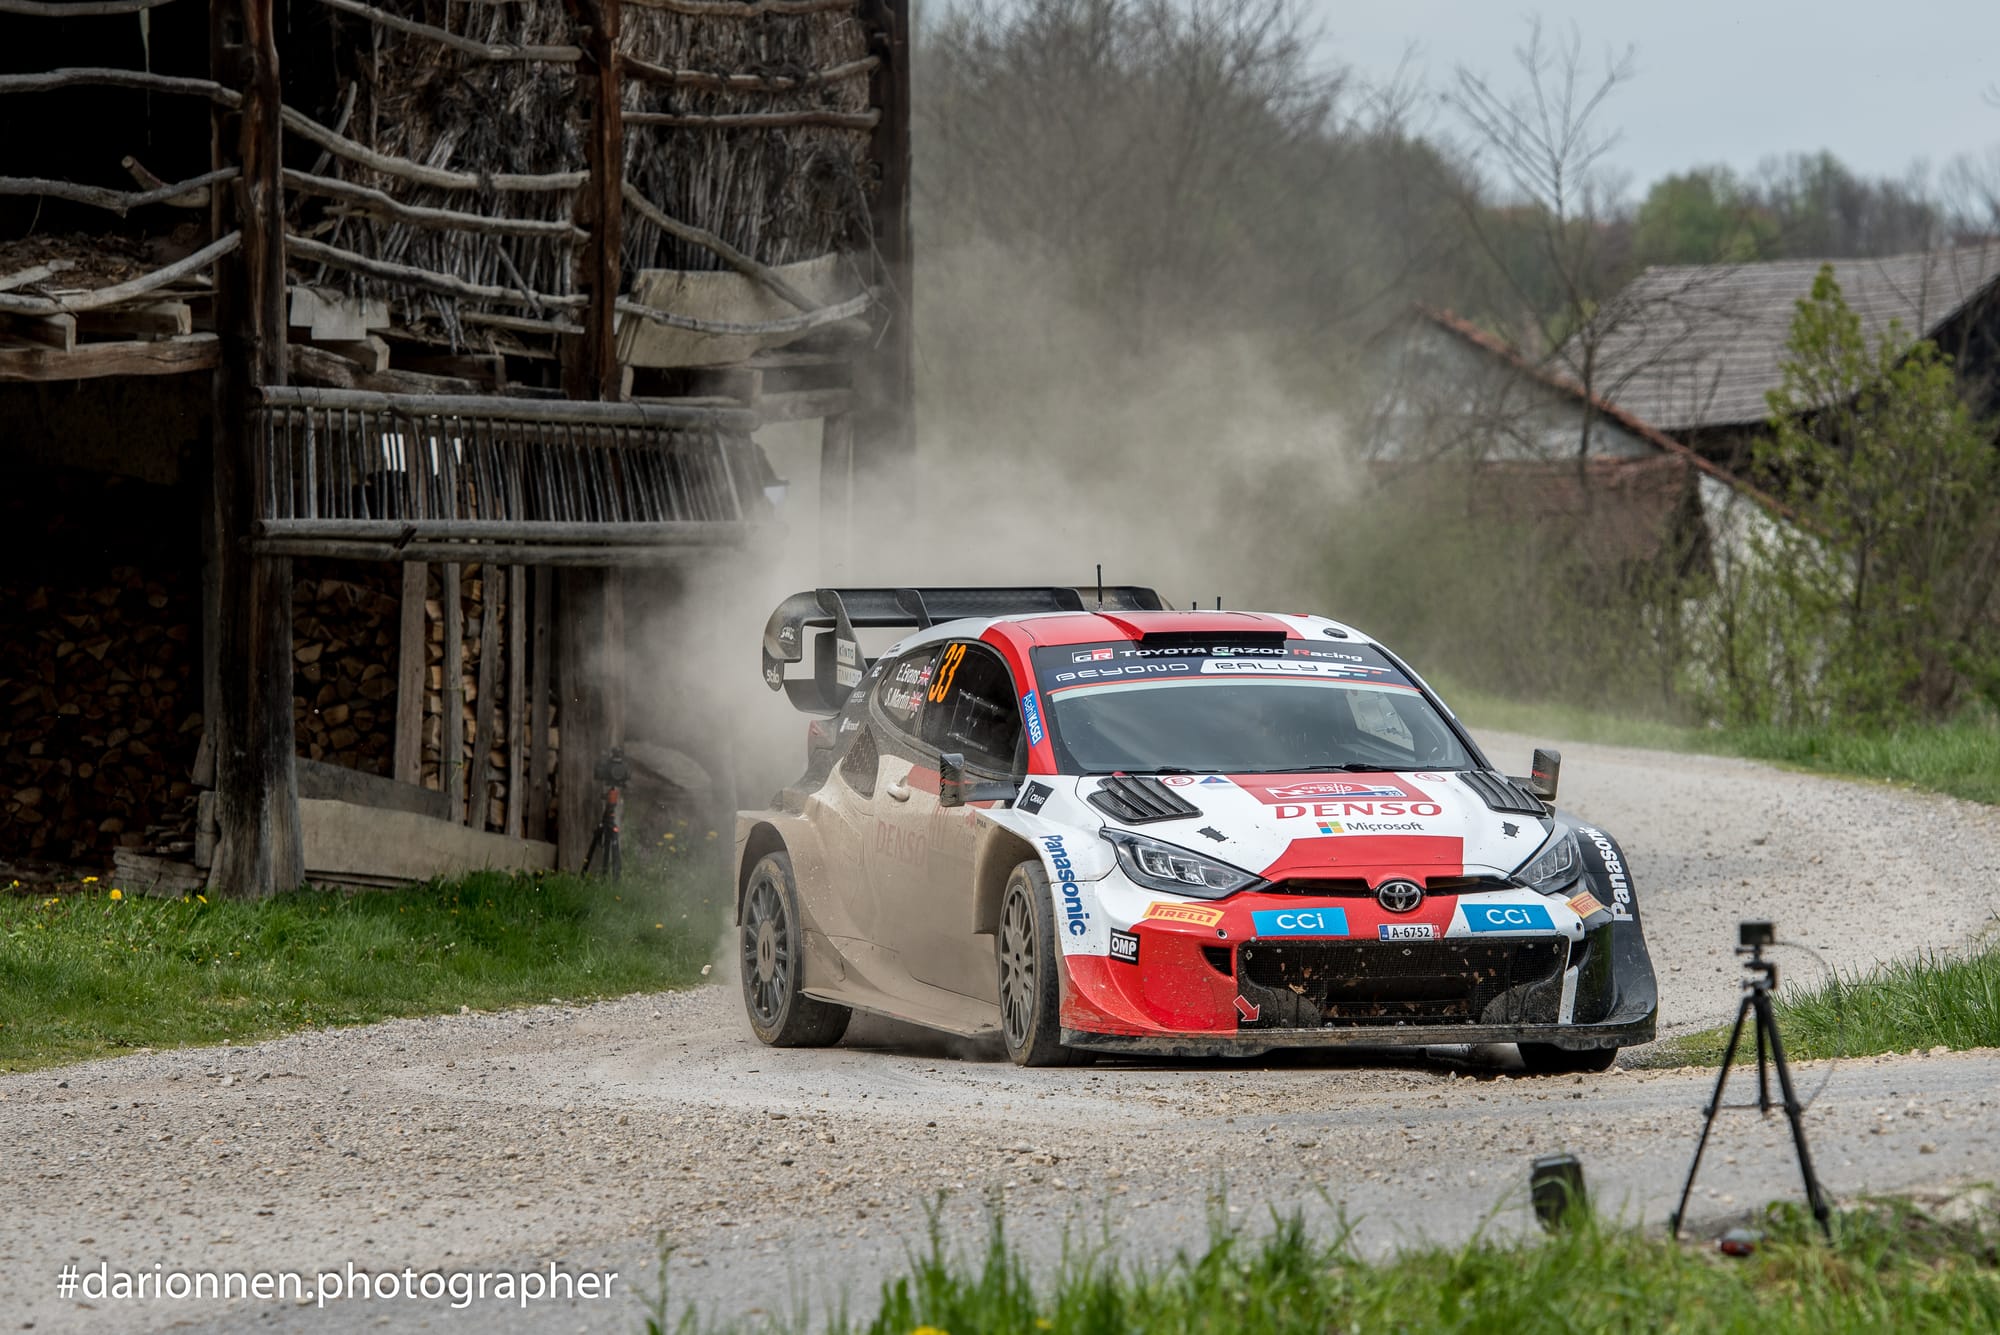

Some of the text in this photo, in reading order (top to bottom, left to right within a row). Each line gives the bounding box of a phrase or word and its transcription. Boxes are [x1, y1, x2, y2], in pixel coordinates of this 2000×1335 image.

[1073, 646, 1363, 663] GR TOYOTA GAZOO Racing
[928, 643, 967, 703] 33
[1056, 662, 1319, 682] BEYOND RALLY
[1274, 803, 1443, 820] DENSO
[1346, 821, 1425, 832] Microsoft
[876, 819, 929, 866] DENSO
[1578, 827, 1634, 921] Panasonic
[1040, 835, 1090, 937] Panasonic
[1149, 904, 1217, 923] PIRELLI
[1391, 926, 1431, 938] A-6752
[1112, 939, 1138, 956] OMP
